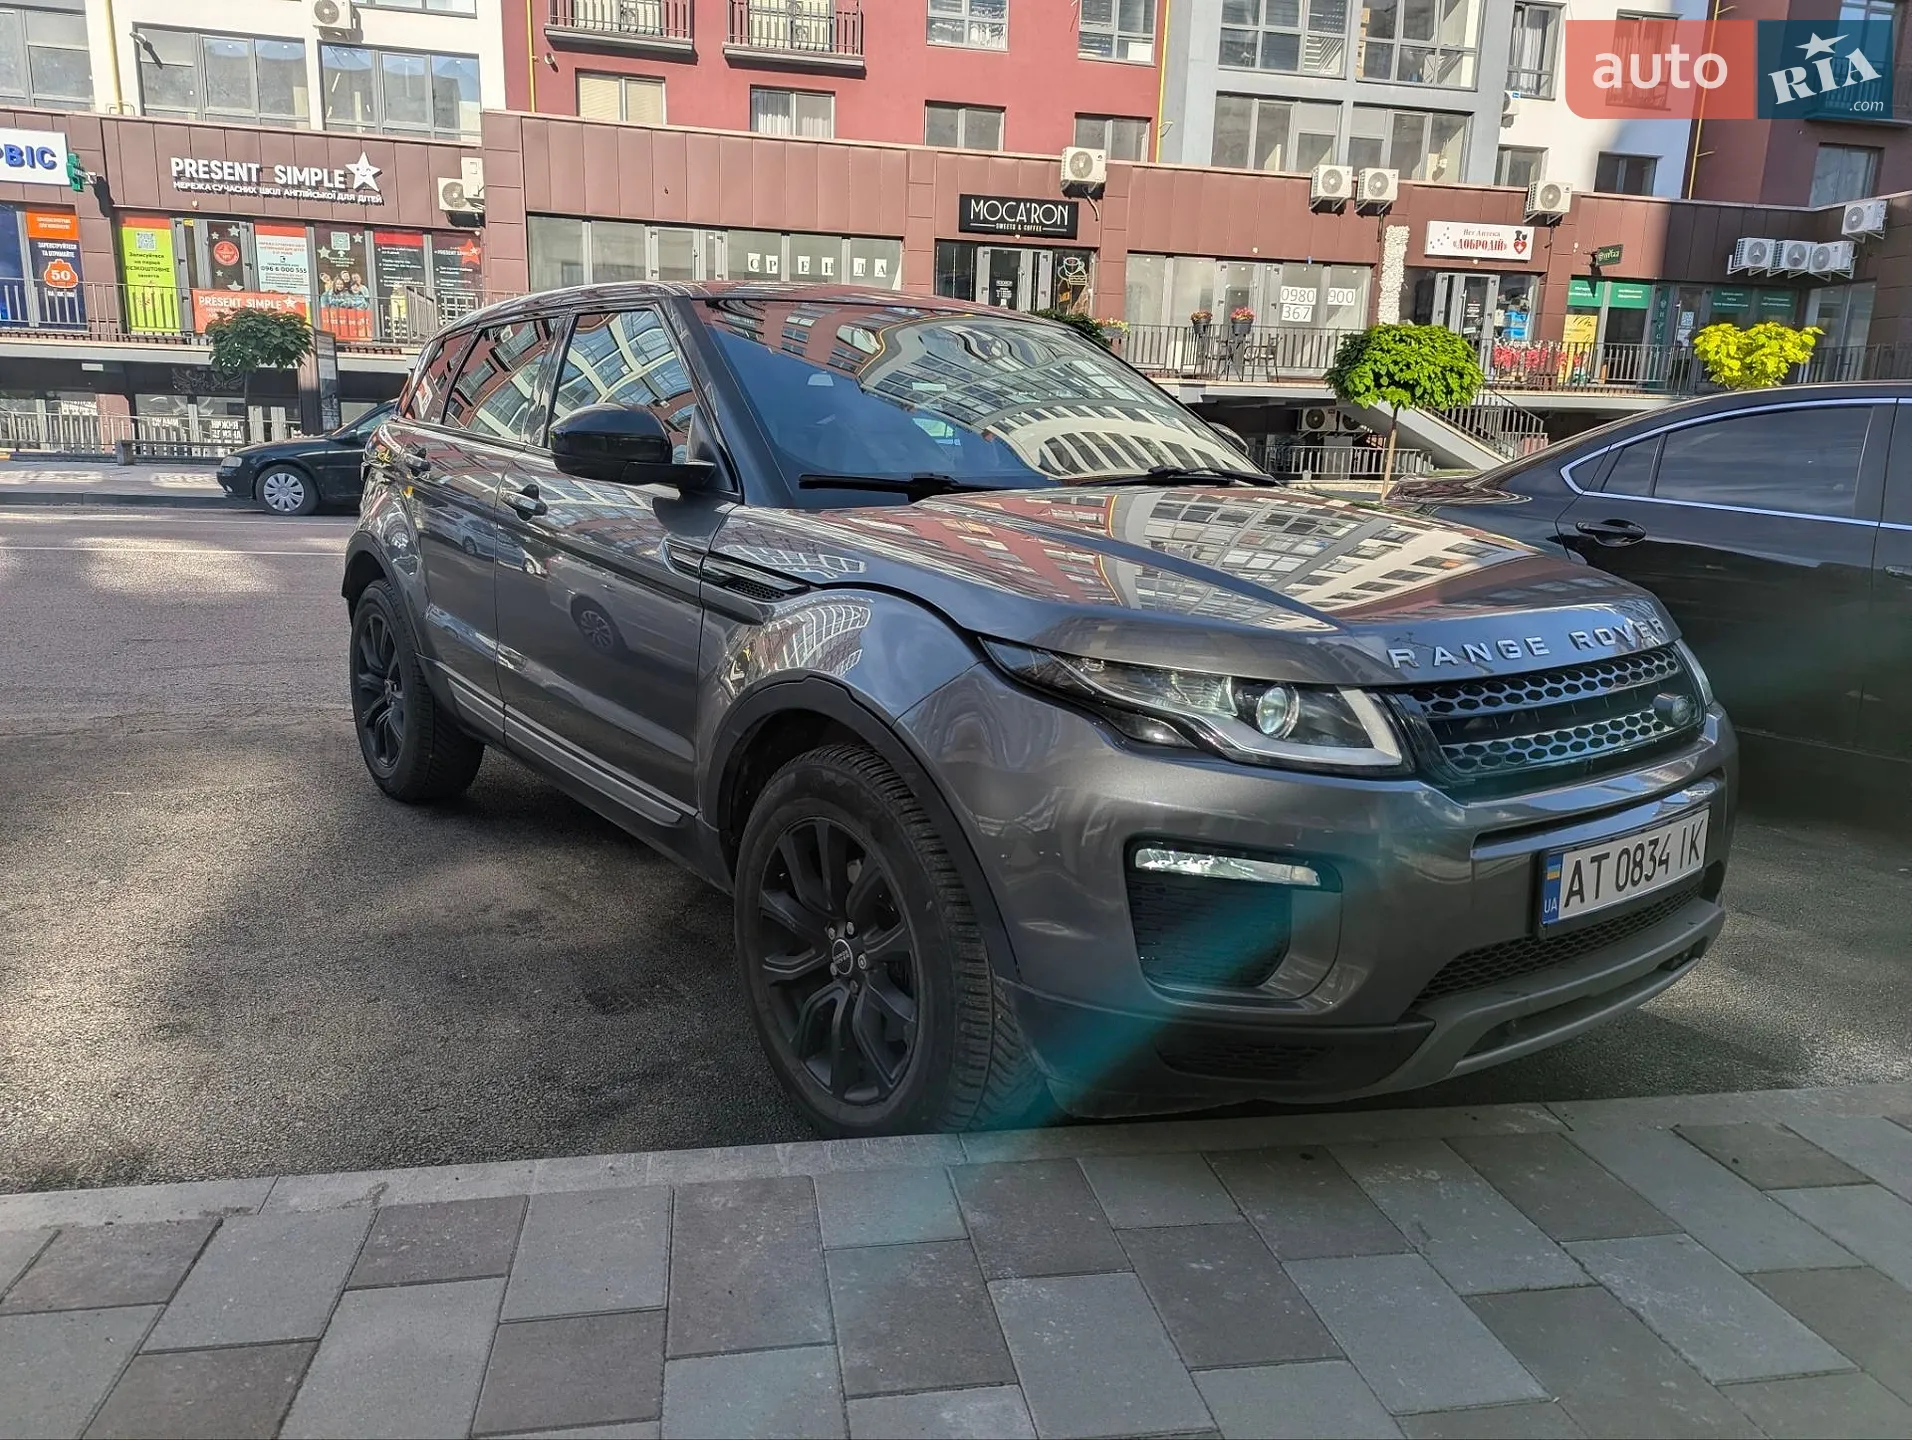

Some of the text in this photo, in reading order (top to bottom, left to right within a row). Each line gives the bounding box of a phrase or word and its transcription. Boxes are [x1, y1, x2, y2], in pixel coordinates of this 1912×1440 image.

[0, 144, 57, 170] ВІС
[170, 157, 346, 189] PRESENT SIMPLE
[173, 181, 383, 203] МЕРЕЖА СУЧАСНИХ ШКІЛ АНГЛІЙСЬКОЇ ДЛЯ ДІТЕЙ
[970, 198, 1069, 226] MOCA'RON
[51, 269, 71, 281] 50
[198, 296, 282, 311] PRESENT SIMPLE
[1281, 288, 1354, 304] 0980 900
[1283, 305, 1311, 320] 367
[1386, 617, 1666, 669] RANGE ROVER
[1563, 818, 1704, 908] AT 0834 IK
[1543, 898, 1558, 913] UA
